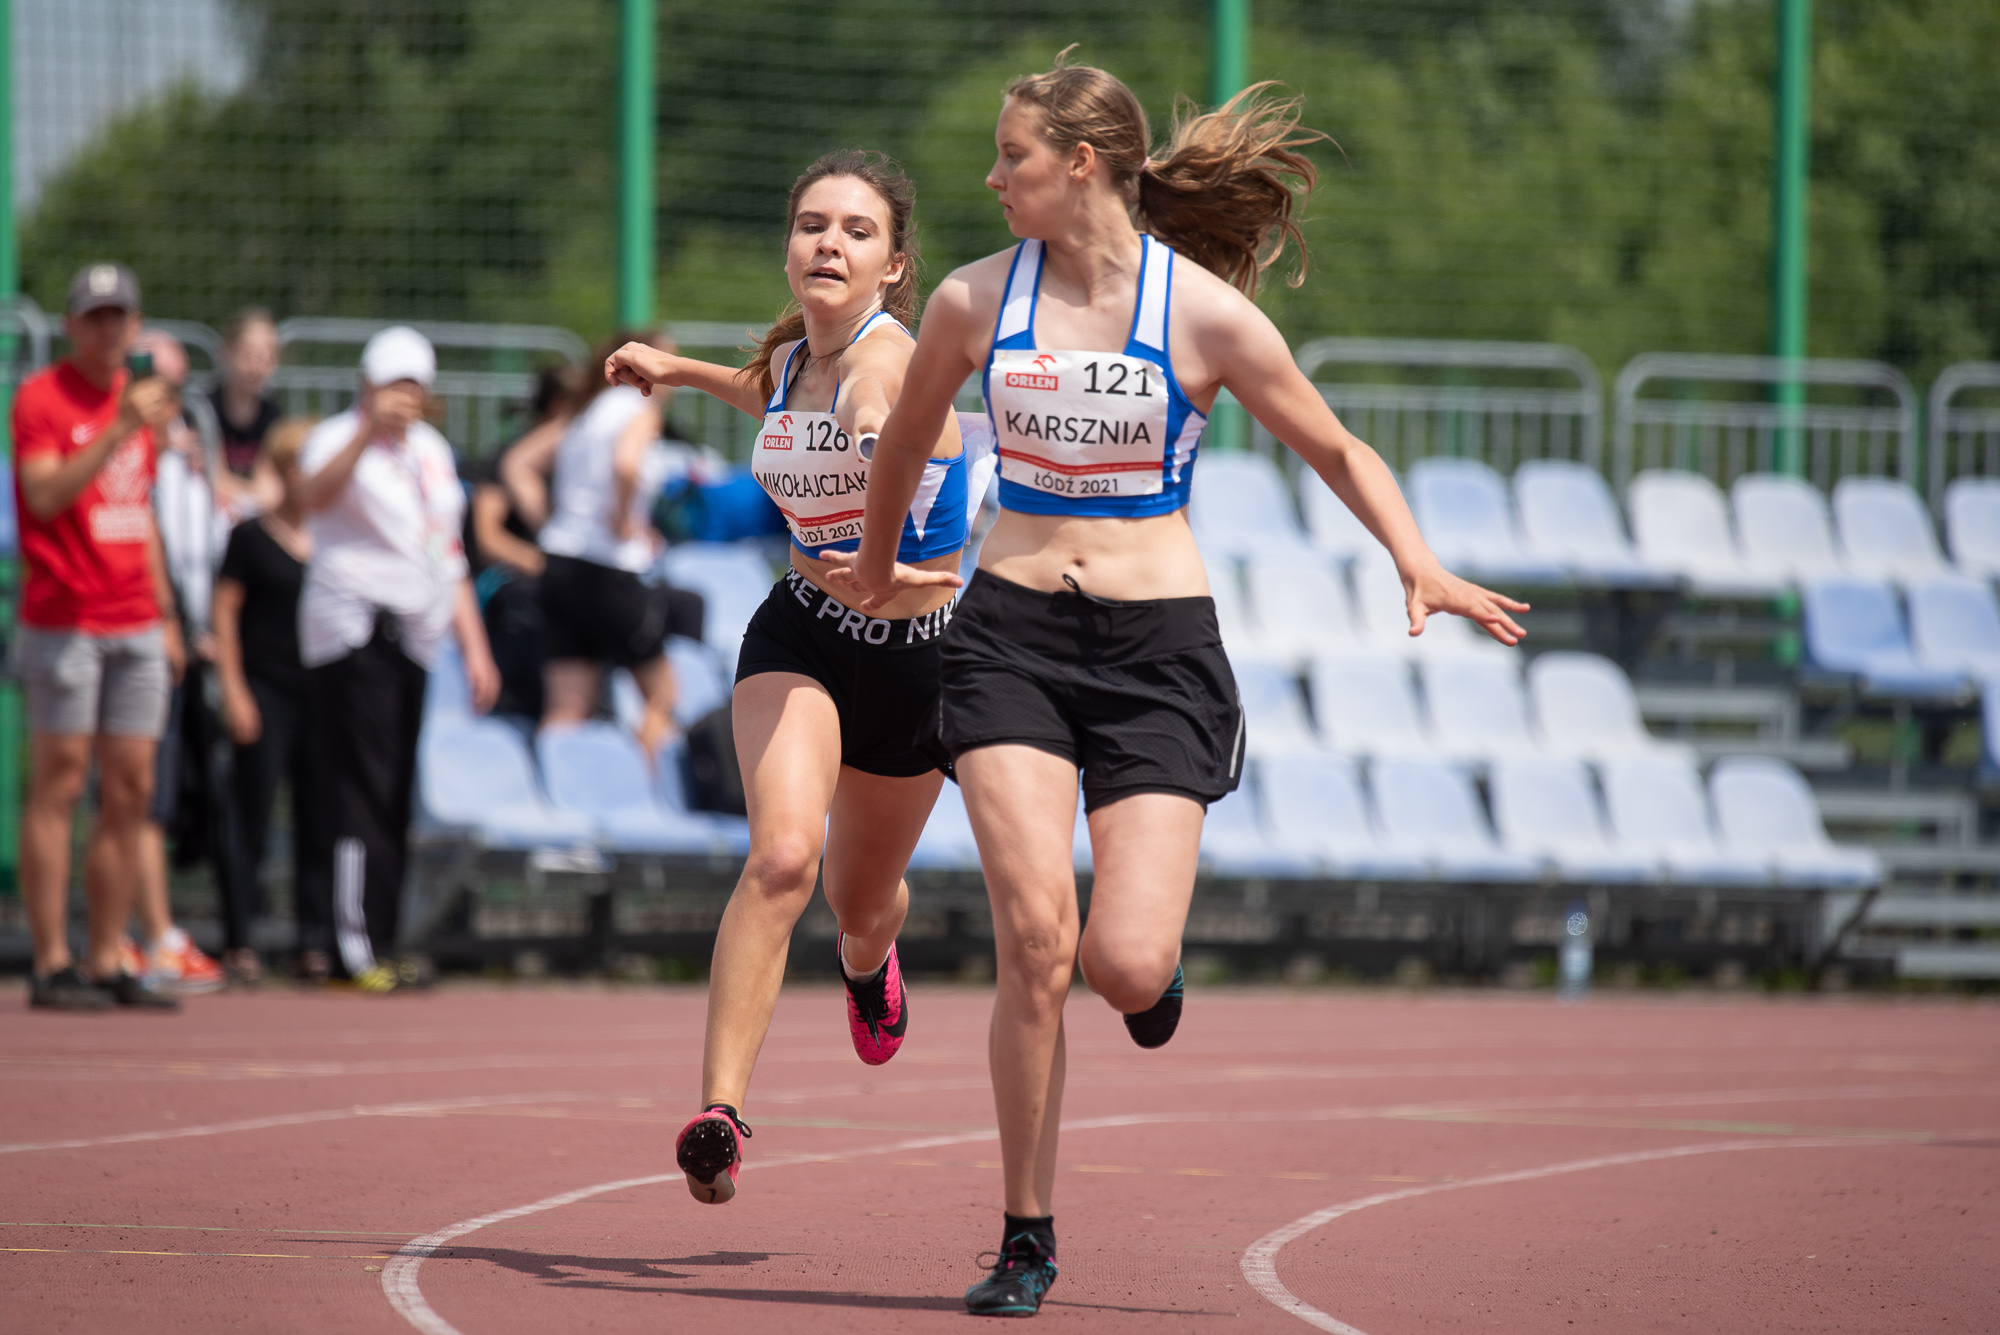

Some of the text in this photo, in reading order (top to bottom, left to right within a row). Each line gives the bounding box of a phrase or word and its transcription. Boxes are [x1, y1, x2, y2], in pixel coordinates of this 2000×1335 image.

[1007, 373, 1056, 390] ORLEN
[1084, 361, 1153, 397] 121
[806, 420, 849, 452] 126
[1005, 410, 1152, 445] KARSZNIA
[764, 436, 792, 449] ORLEN
[1033, 471, 1118, 494] ŁÓDŹ 2021
[797, 521, 864, 544] ÓDŹ 2021
[816, 595, 892, 645] PRO
